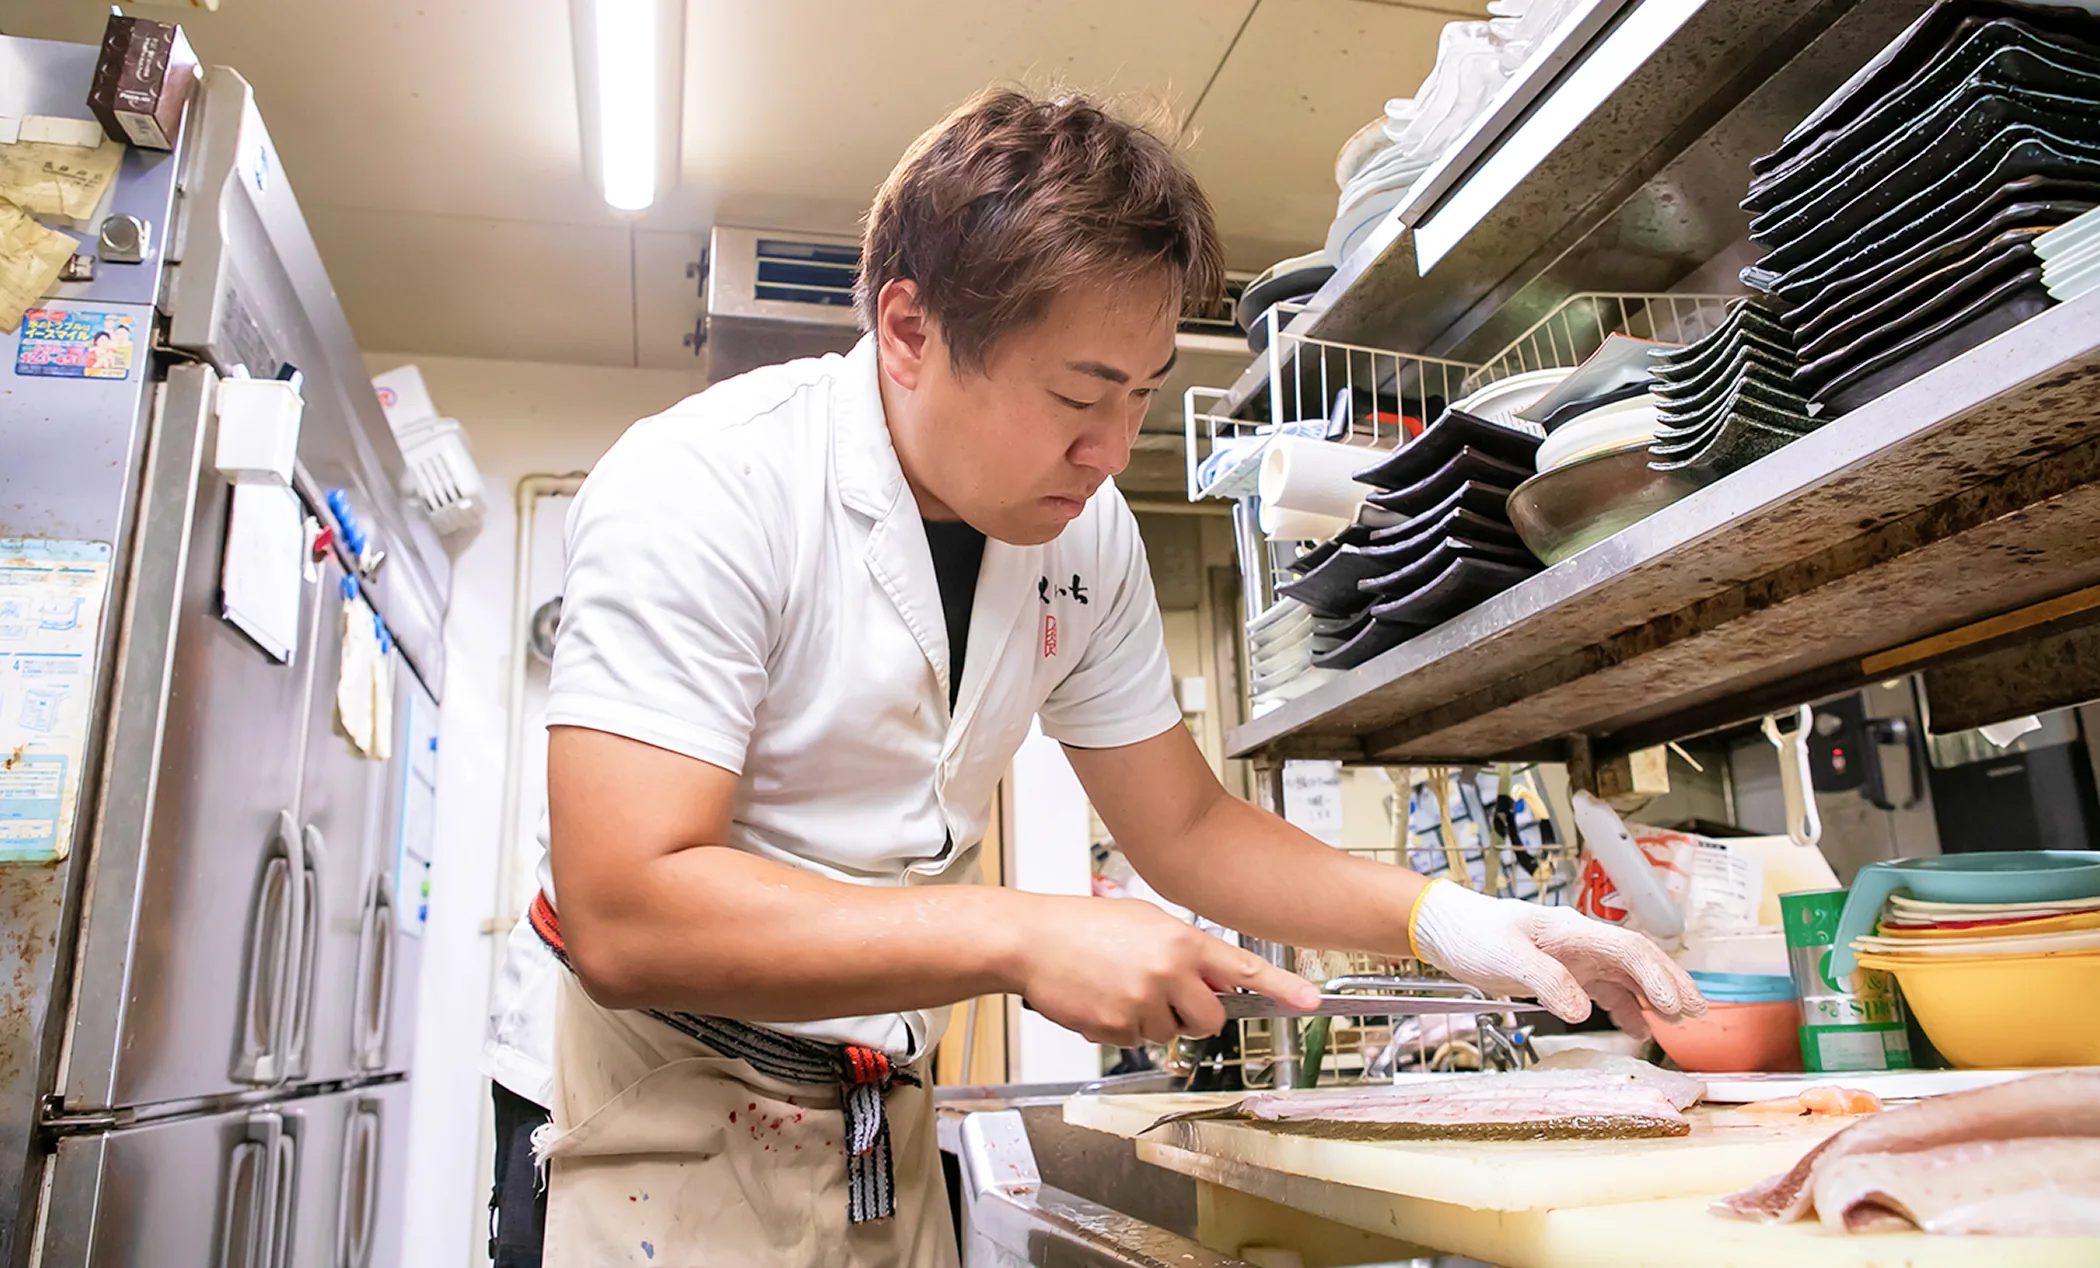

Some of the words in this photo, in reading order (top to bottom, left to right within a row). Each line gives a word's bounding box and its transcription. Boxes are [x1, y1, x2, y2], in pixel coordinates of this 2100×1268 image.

[25, 329, 90, 340] イースマイル
